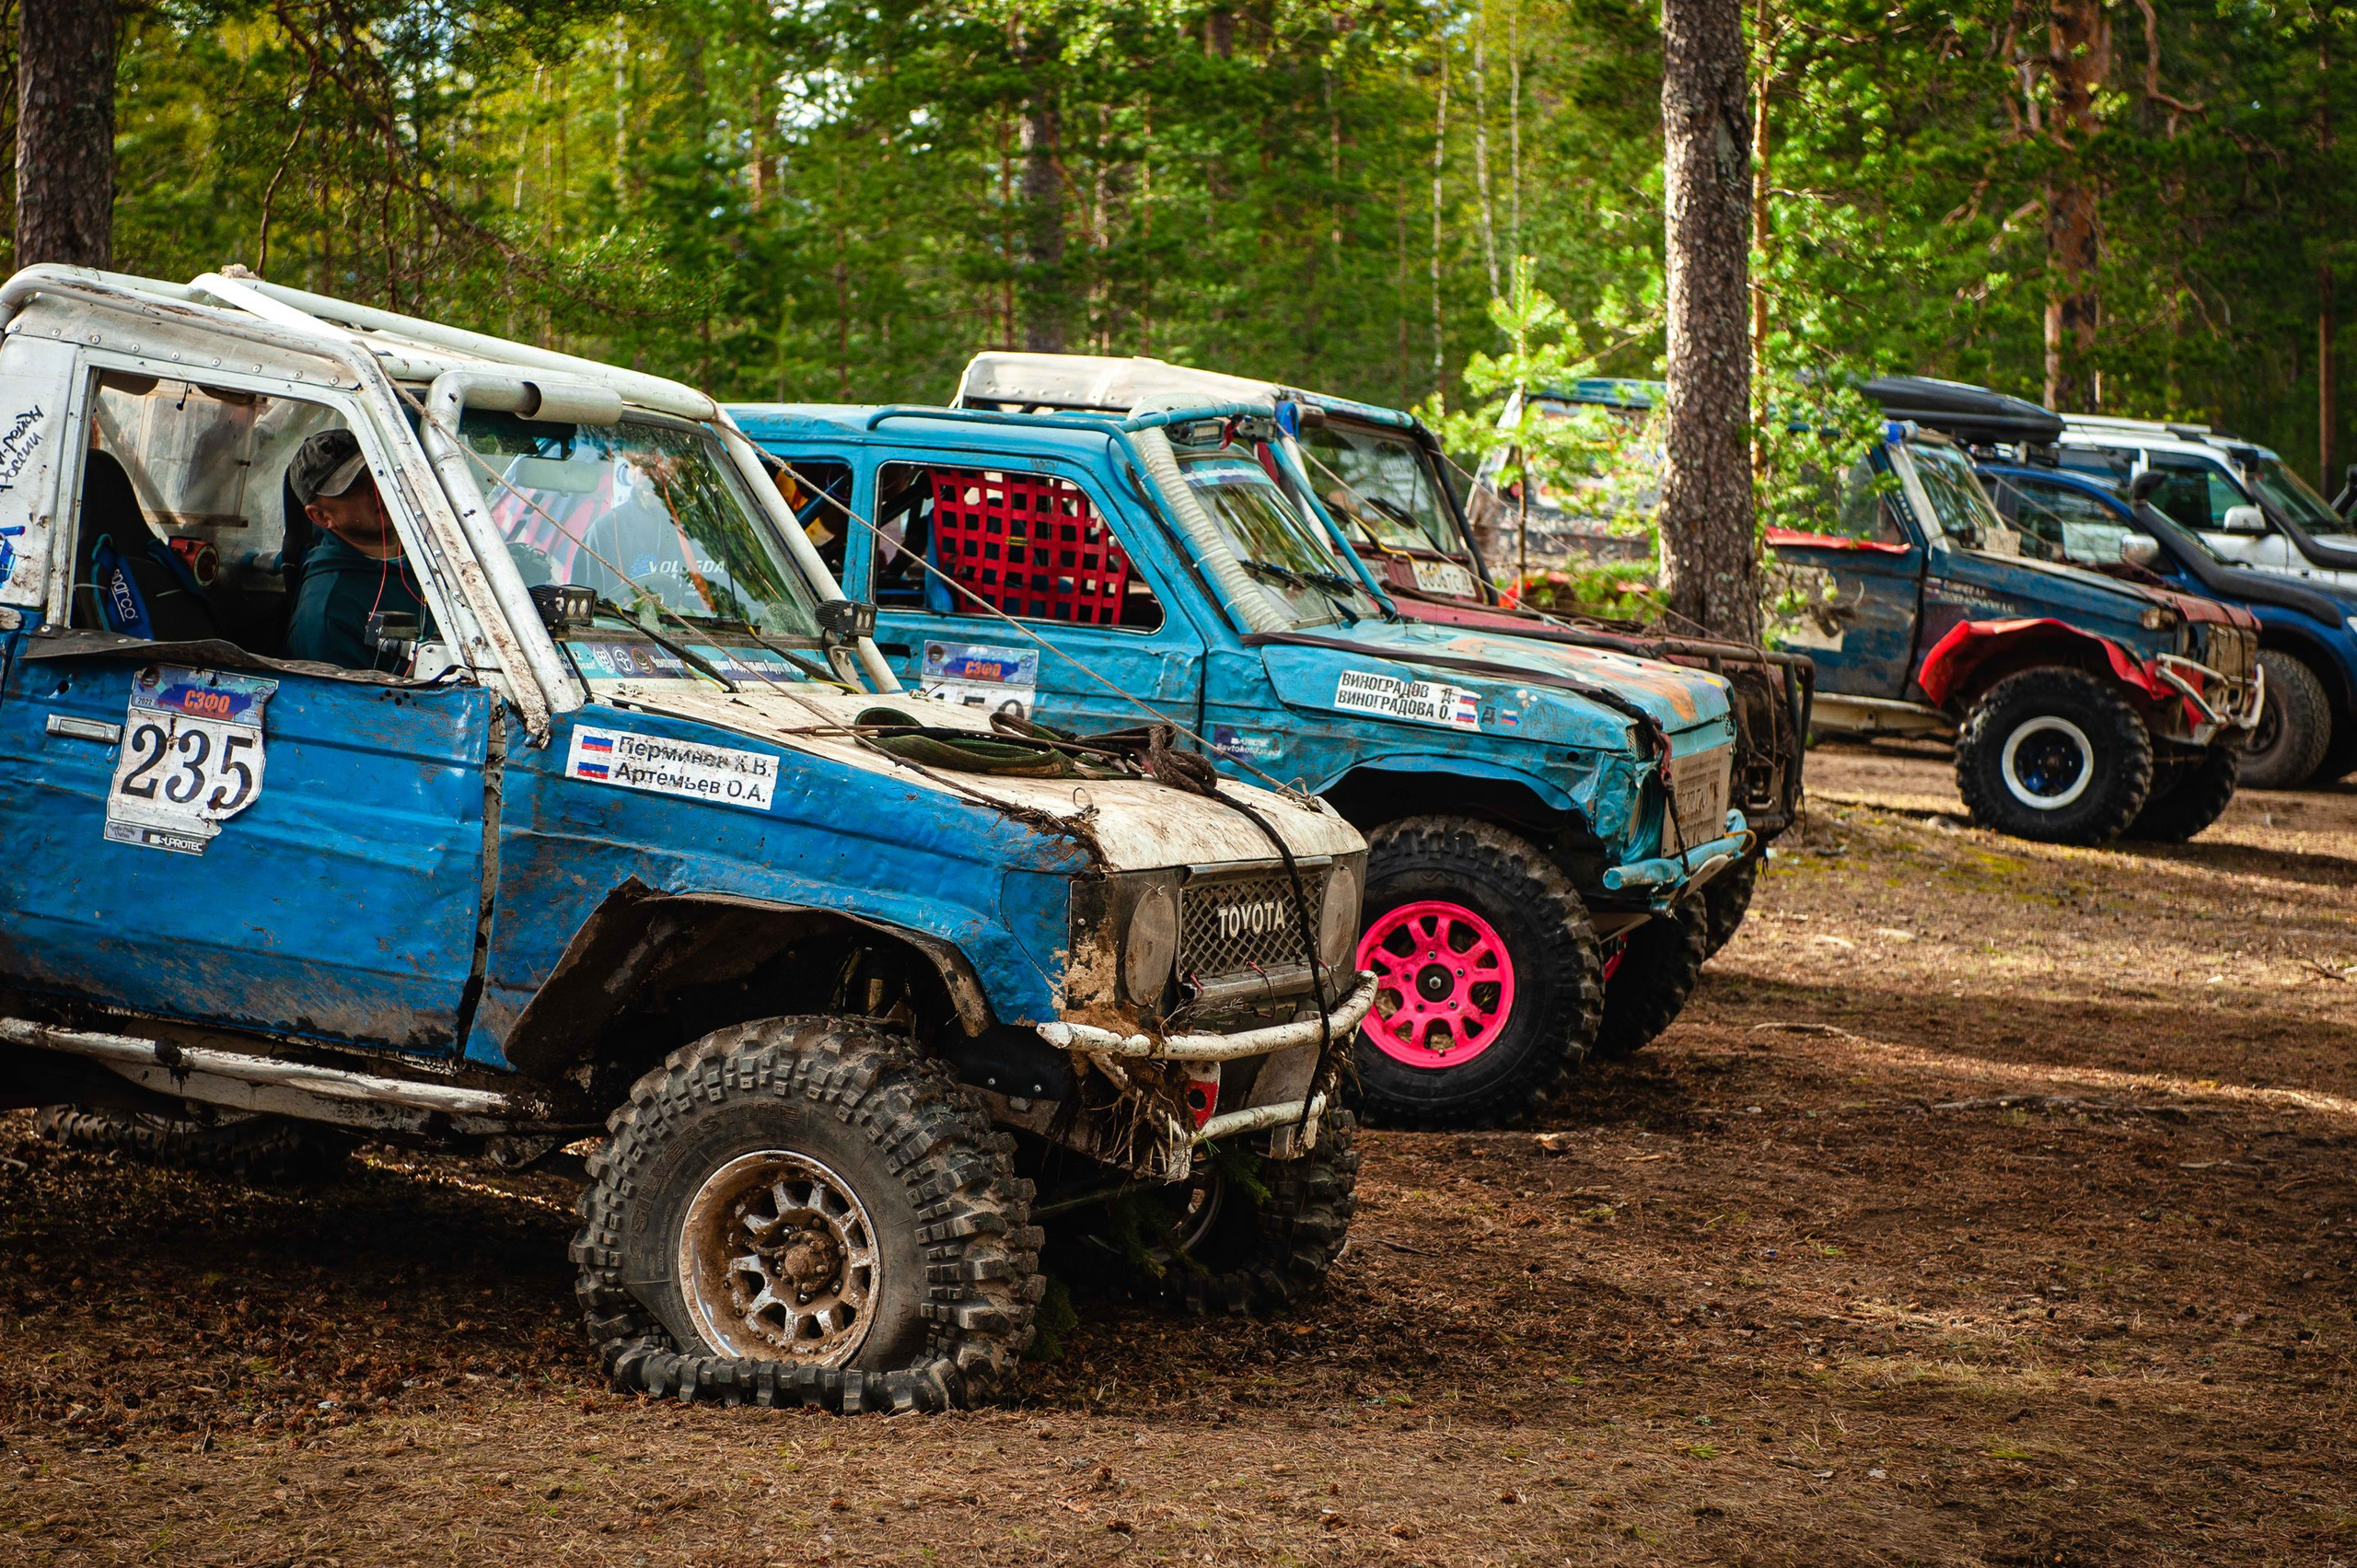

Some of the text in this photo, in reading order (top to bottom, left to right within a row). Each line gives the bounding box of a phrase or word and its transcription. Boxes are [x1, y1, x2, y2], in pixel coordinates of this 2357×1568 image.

[649, 560, 726, 574] VOLGDA
[1341, 672, 1430, 698] ВИНОГРАДОВ
[138, 697, 153, 706] 2022
[184, 691, 230, 714] СЗФО
[1338, 690, 1452, 721] ВИНОГРАДОВА О.
[121, 724, 253, 809] 235
[615, 762, 766, 803] Артемьев О.А.
[158, 835, 203, 852] SUPROTEC
[1218, 900, 1285, 939] TOYOTA
